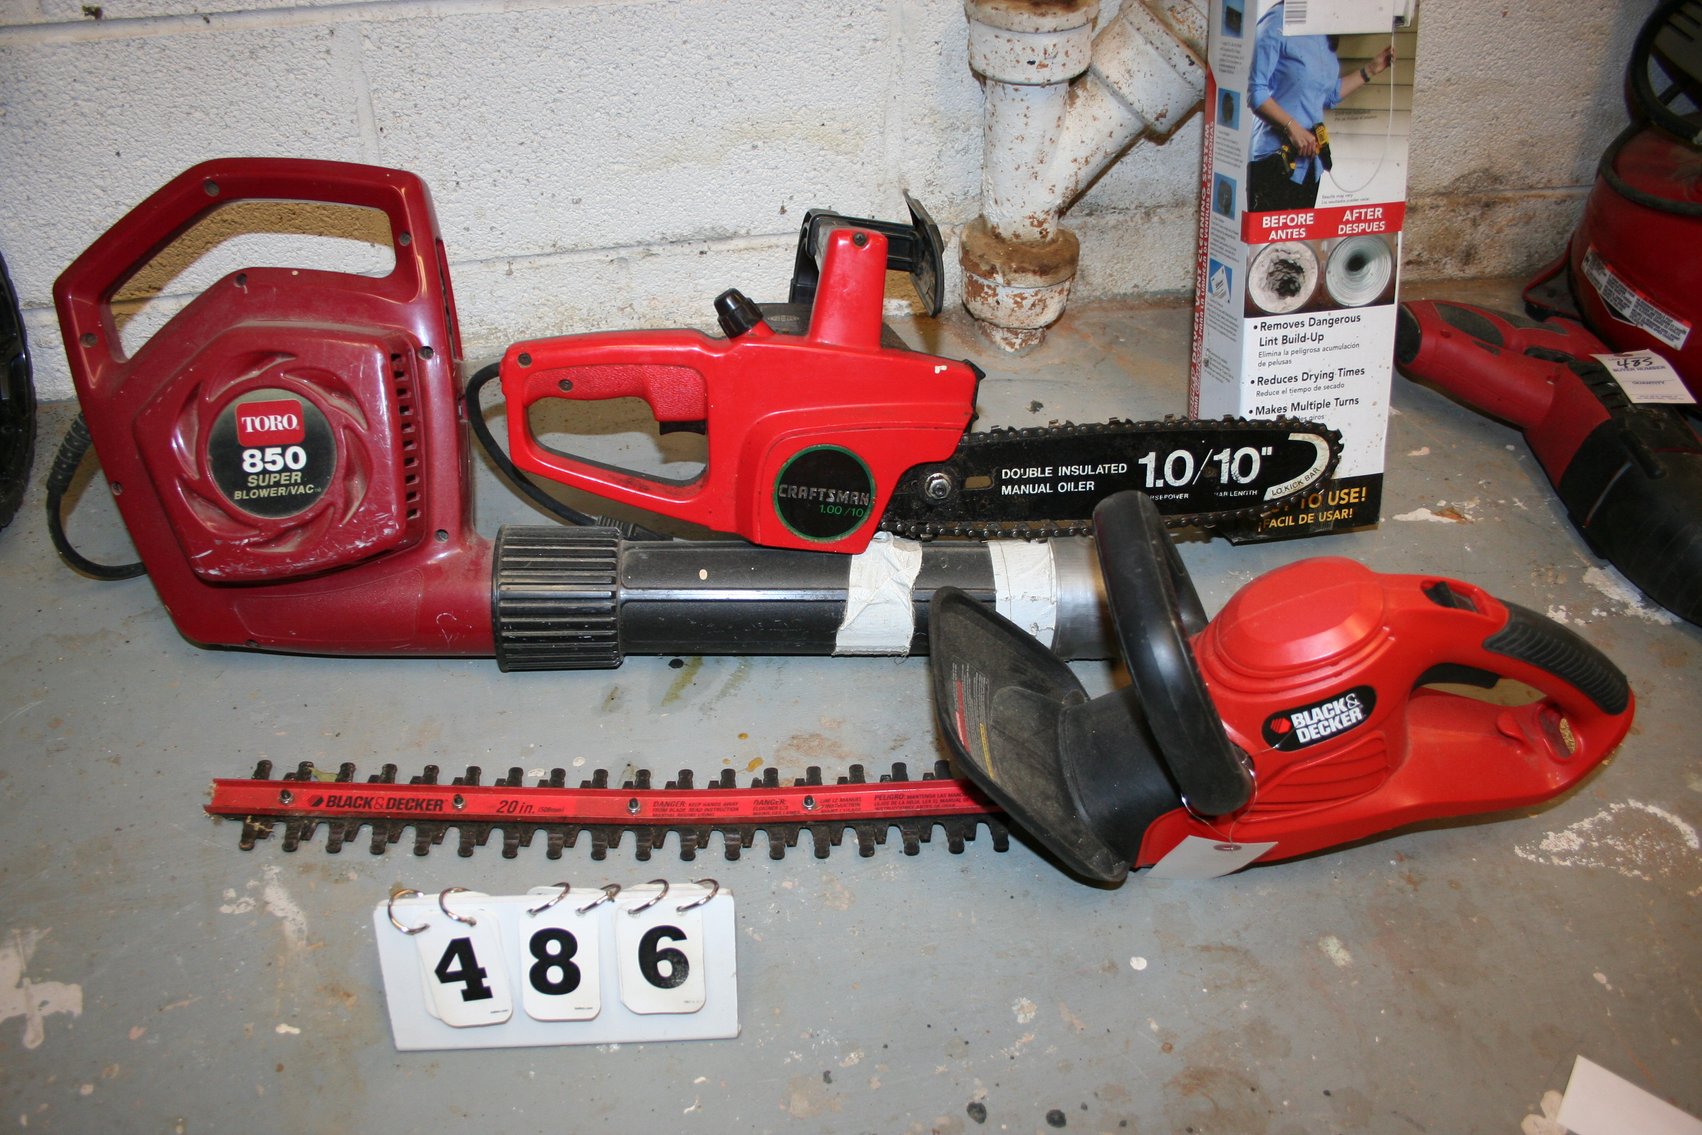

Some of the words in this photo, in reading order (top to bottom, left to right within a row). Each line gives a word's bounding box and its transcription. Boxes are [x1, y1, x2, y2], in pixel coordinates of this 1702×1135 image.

[1262, 213, 1315, 228] BEFORE
[1343, 207, 1383, 221] AFTER
[1268, 228, 1306, 240] ANTES
[1337, 221, 1386, 235] DESPUES
[1260, 321, 1305, 332] Removes
[1308, 314, 1361, 327] Dangerous
[1259, 336, 1278, 347] Lint
[1281, 332, 1324, 345] Build-Up
[1290, 345, 1320, 356] peligrosa
[1322, 342, 1360, 352] acumulación
[1268, 358, 1292, 367] pelusas
[1257, 374, 1298, 386] Reduces
[1301, 369, 1335, 383] Drying
[1337, 366, 1365, 377] Times
[1289, 386, 1312, 395] tiempo
[1313, 384, 1321, 392] de
[1323, 382, 1345, 391] secado
[1255, 404, 1287, 415] Makes
[1290, 398, 1331, 412] Multiple
[1334, 396, 1359, 407] Turns
[241, 413, 298, 433] TORO
[242, 446, 307, 473] 850
[247, 471, 302, 487] SUPER
[1001, 466, 1053, 479] DOUBLE
[1058, 463, 1127, 476] INSULATED
[1284, 480, 1304, 491] KICK
[1304, 467, 1320, 481] BAR
[234, 484, 314, 500] BLOWER/VAC
[779, 484, 870, 506] CRAFTSMAN
[1001, 483, 1053, 495] MANUAL
[1057, 481, 1095, 493] OILER
[1328, 487, 1366, 506] USE!
[820, 504, 842, 515] 1.00
[1298, 513, 1315, 524] DE
[1319, 508, 1353, 522] USAR!
[1290, 693, 1361, 729] BLACK&
[1296, 708, 1362, 744] DECKER
[496, 800, 519, 814] 20
[519, 802, 535, 814] in.
